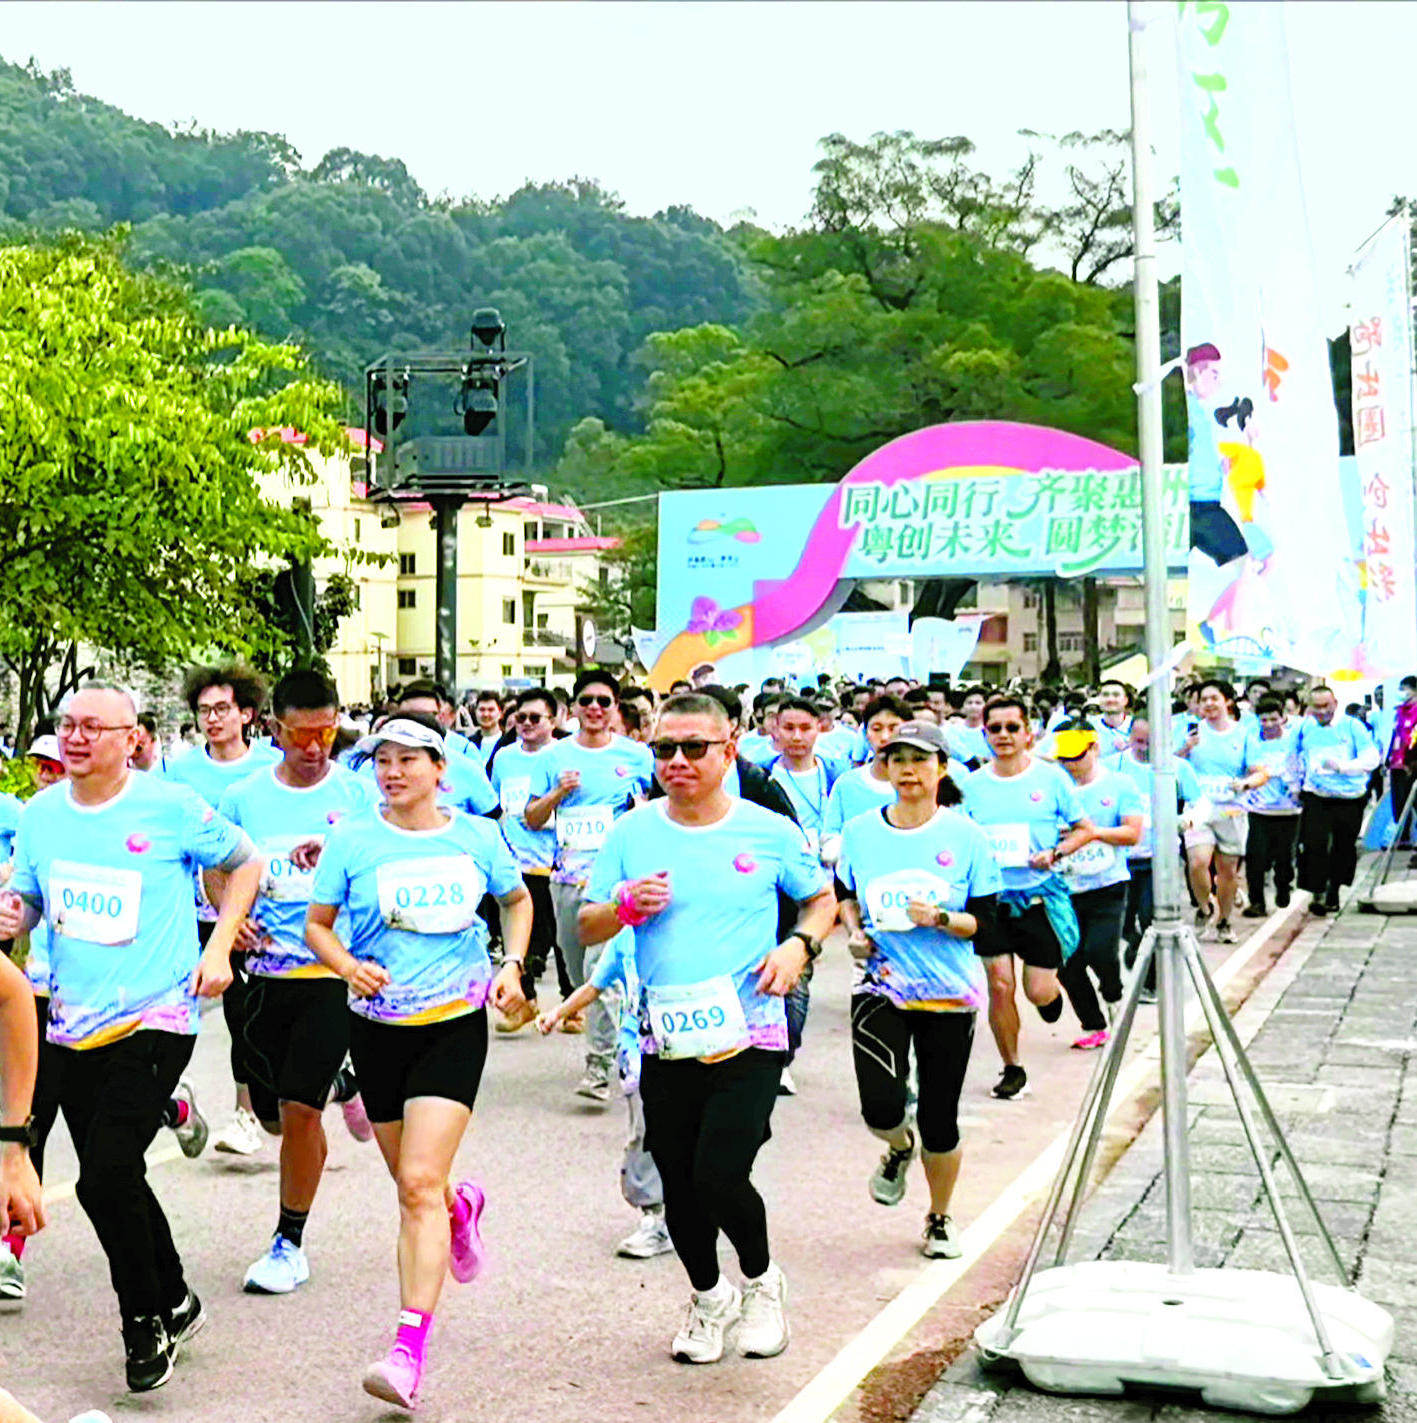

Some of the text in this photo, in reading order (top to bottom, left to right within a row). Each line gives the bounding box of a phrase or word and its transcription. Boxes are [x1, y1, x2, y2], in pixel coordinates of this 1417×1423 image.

[843, 478, 1000, 525] 同心同行
[859, 518, 1031, 564] 粤创未来
[565, 820, 605, 836] 0710
[62, 887, 123, 919] 0400
[395, 882, 465, 909] 0228
[661, 1005, 726, 1034] 0269
